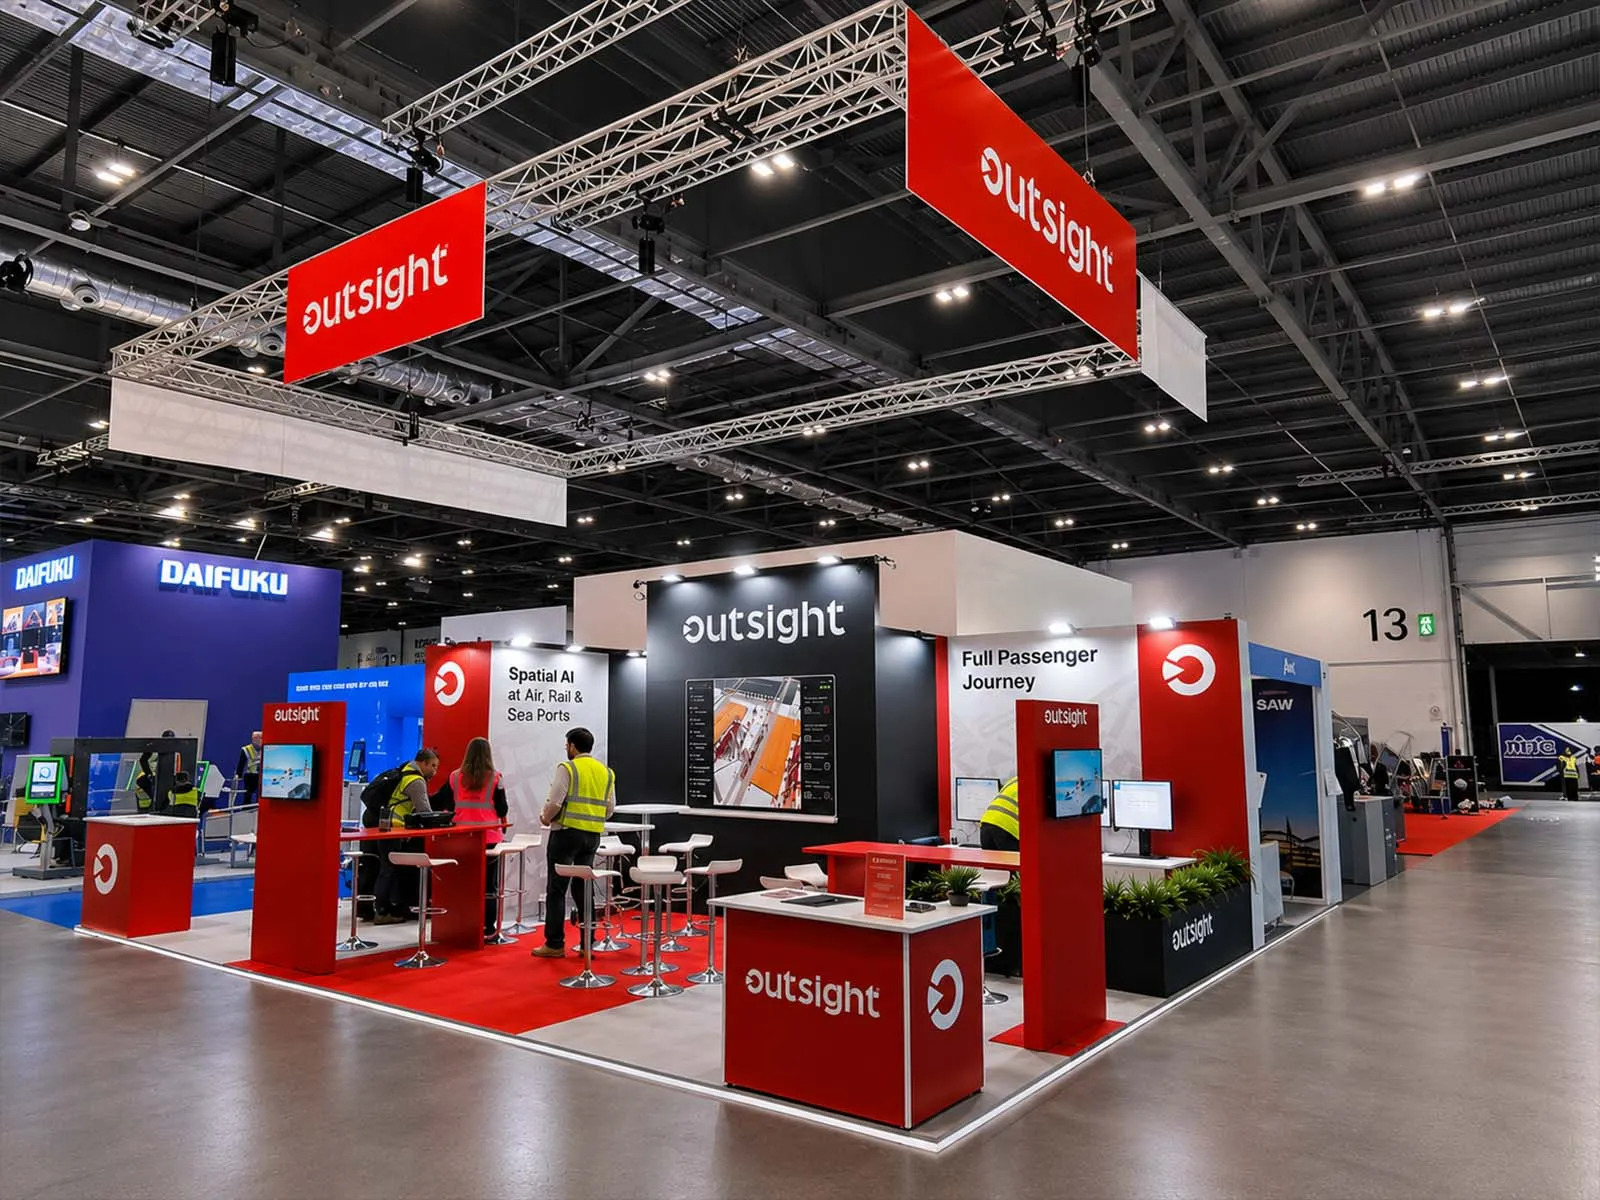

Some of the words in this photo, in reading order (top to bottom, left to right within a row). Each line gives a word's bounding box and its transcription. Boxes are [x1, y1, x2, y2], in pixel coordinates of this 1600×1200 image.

[302, 244, 450, 336] outsight
[15, 555, 75, 591] DAIFUKU
[160, 559, 289, 596] DAIFUKU
[682, 599, 847, 644] outsight
[1363, 607, 1408, 642] 13
[962, 650, 993, 667] Full
[998, 649, 1098, 668] Passenger
[509, 666, 557, 685] Spatial
[560, 670, 575, 684] AI
[962, 674, 1036, 693] Journey
[507, 688, 521, 701] at
[524, 688, 545, 703] Air,
[548, 689, 571, 703] Rail
[574, 690, 583, 704] &
[1256, 698, 1294, 711] SAW
[274, 706, 320, 725] outsight
[507, 707, 533, 722] Sea
[537, 708, 570, 722] Ports
[1044, 707, 1088, 728] outsight
[1172, 912, 1214, 951] outsight
[745, 968, 881, 1018] outsight
